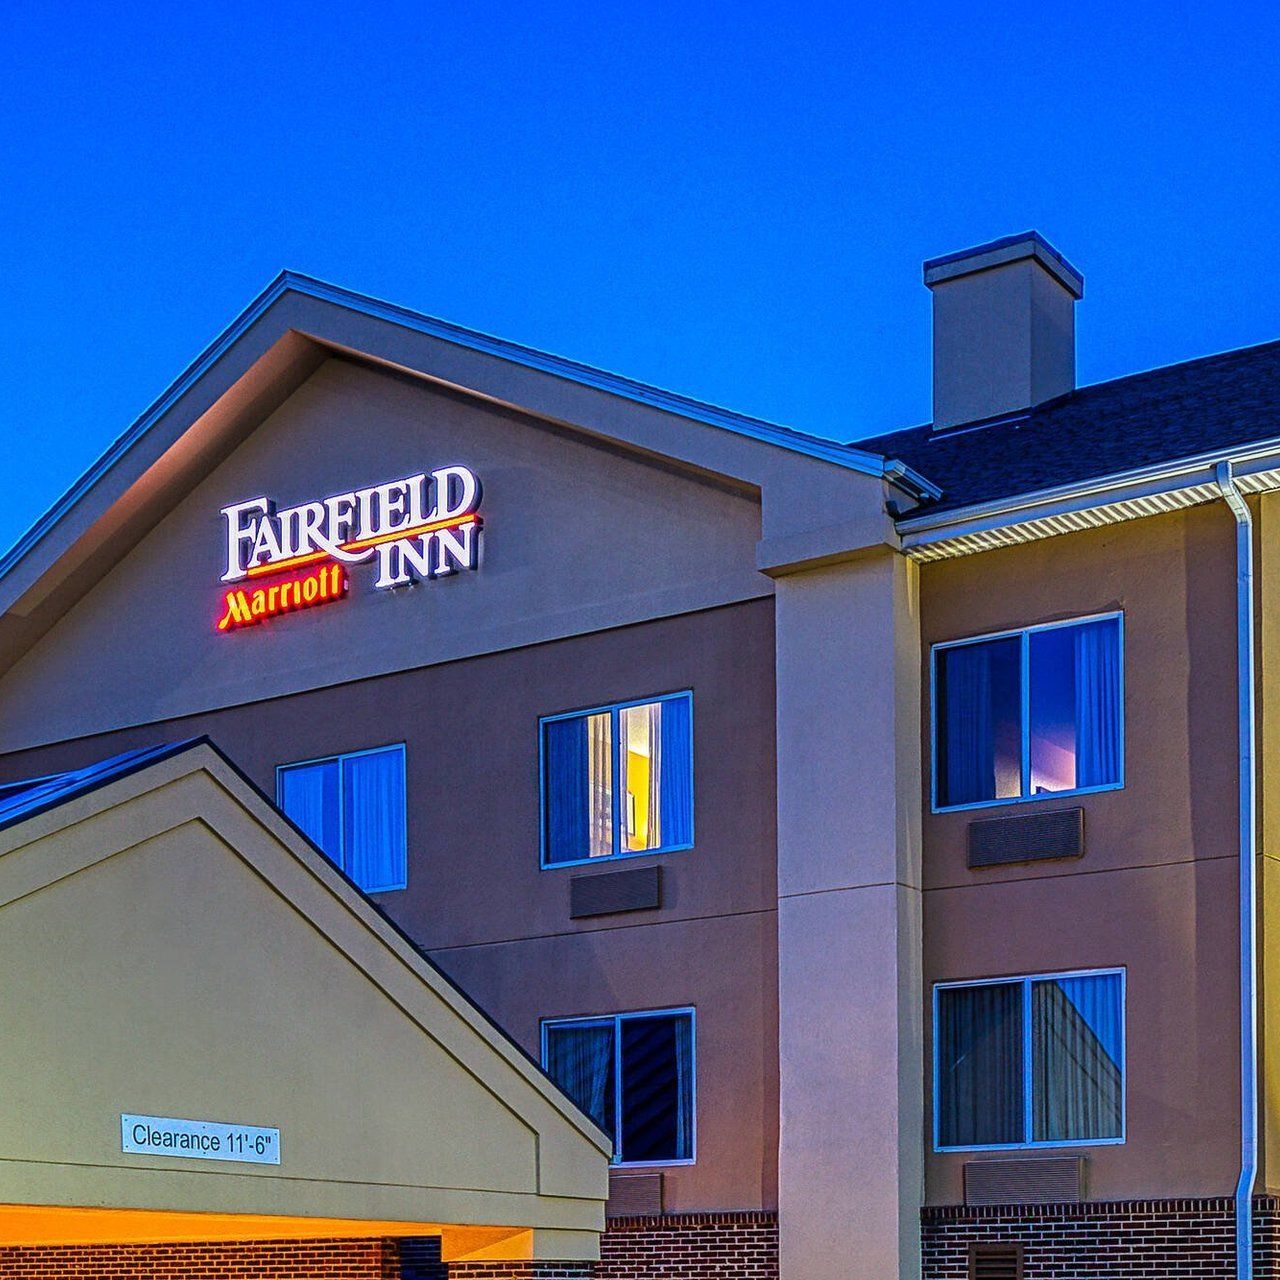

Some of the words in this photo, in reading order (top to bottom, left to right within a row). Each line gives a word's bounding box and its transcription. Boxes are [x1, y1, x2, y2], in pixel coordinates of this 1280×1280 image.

[219, 465, 477, 582] FAIRFIELD
[375, 522, 476, 588] INN
[217, 563, 342, 630] Marriott
[133, 1124, 220, 1151] Clearance
[227, 1132, 271, 1155] 11'-6"
